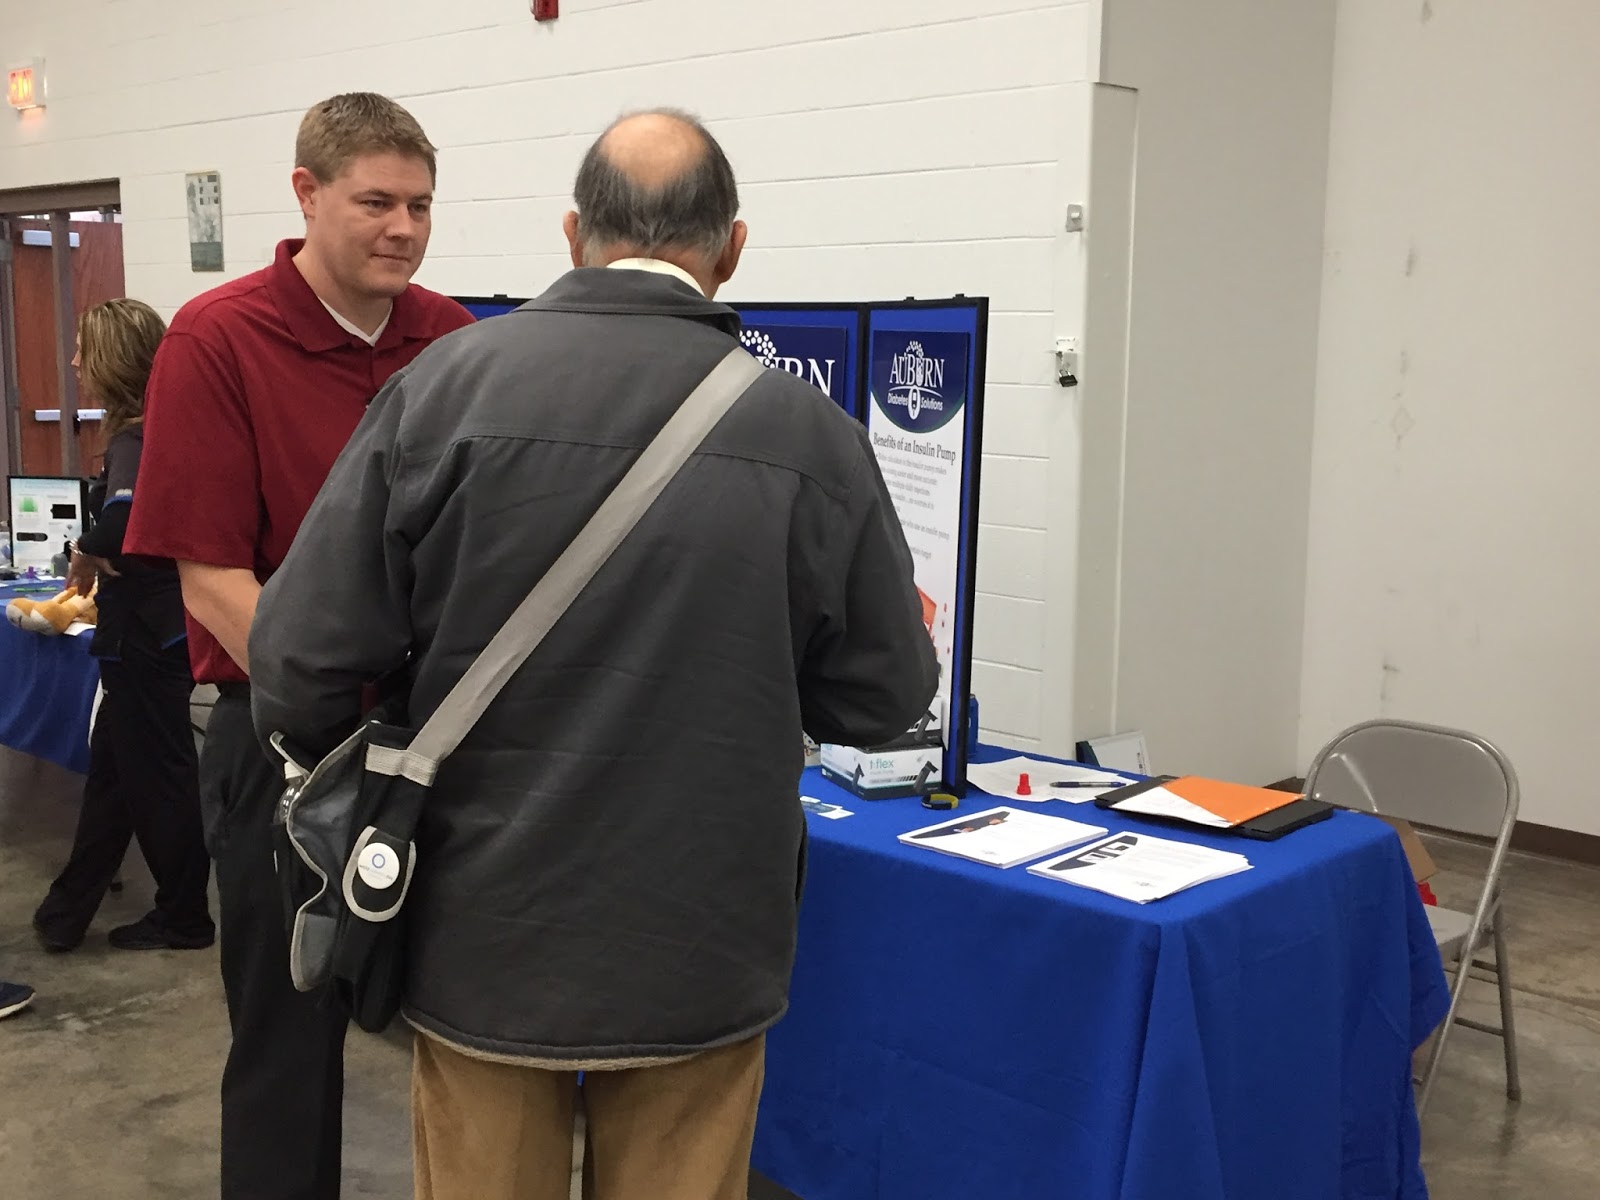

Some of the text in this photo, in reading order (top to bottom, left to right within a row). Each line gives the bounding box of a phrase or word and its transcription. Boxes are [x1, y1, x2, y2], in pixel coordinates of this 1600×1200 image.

[889, 352, 945, 388] AUBURN
[887, 392, 943, 411] Diabetes Solutions
[873, 432, 896, 450] Benefits
[897, 437, 904, 451] of
[904, 442, 912, 453] an
[913, 440, 935, 458] Insulin
[936, 444, 956, 466] Pump
